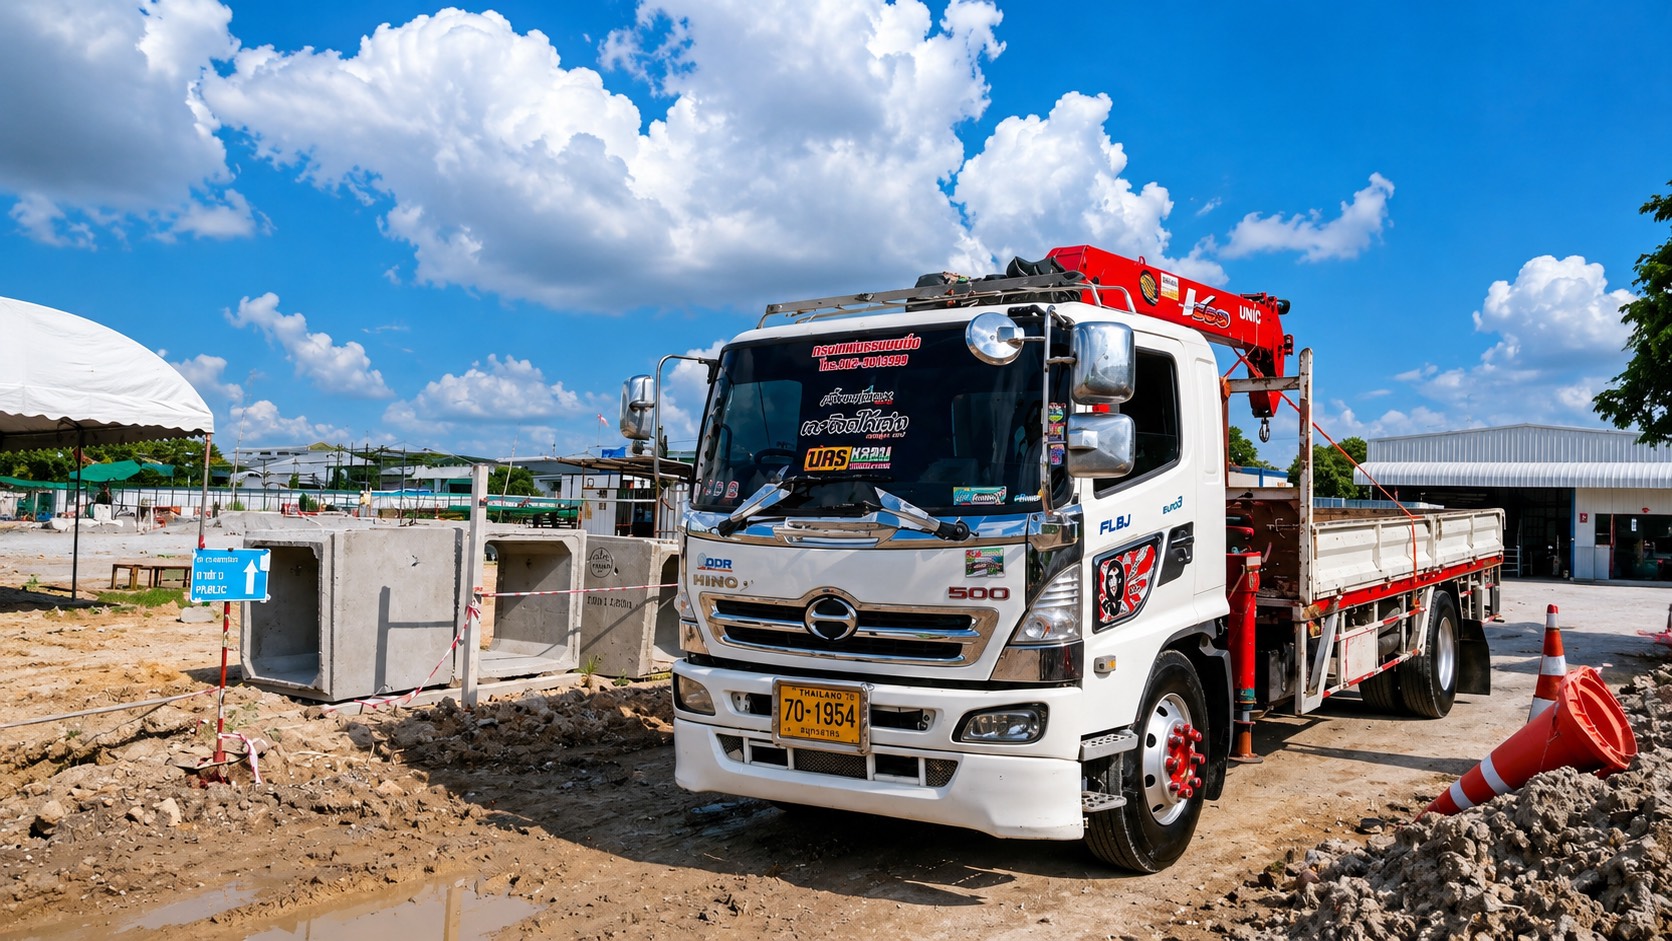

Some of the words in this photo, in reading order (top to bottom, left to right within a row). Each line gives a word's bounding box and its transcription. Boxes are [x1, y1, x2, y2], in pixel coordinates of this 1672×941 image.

[1239, 304, 1262, 325] UNIC
[1099, 513, 1131, 535] FLBJ
[693, 574, 739, 589] HINO
[948, 587, 1010, 601] 500
[784, 698, 856, 728] 70-1954
